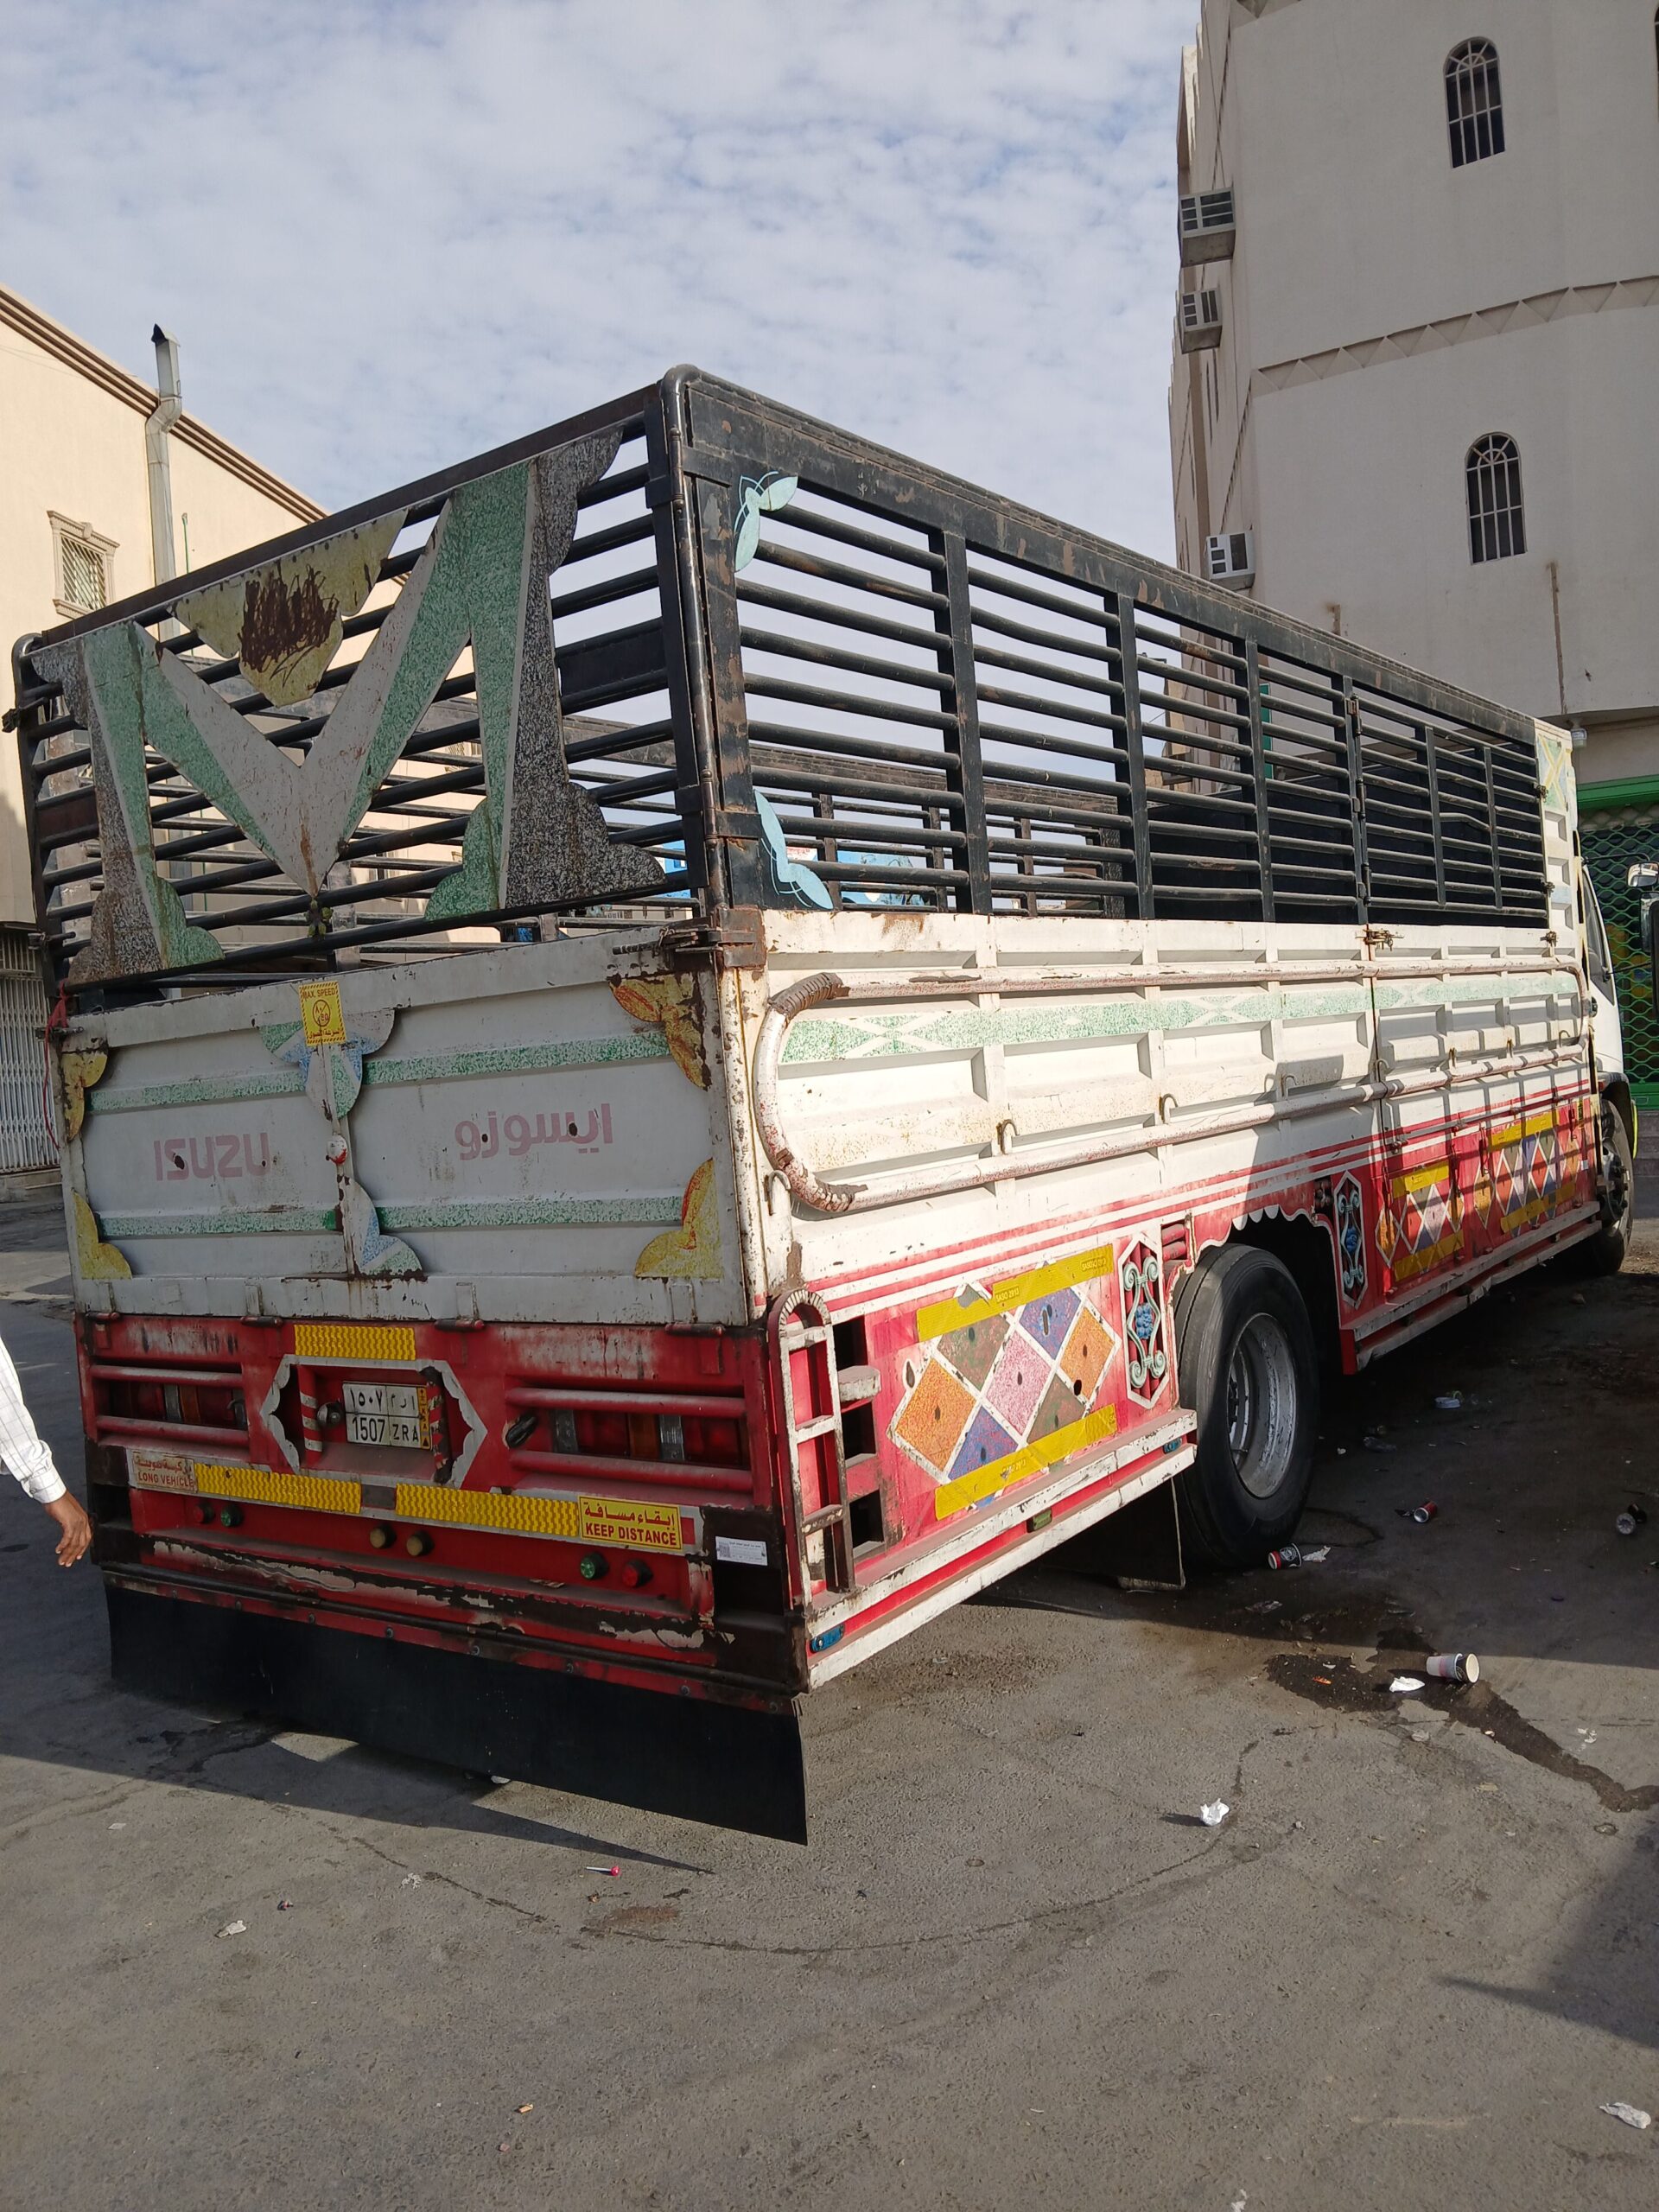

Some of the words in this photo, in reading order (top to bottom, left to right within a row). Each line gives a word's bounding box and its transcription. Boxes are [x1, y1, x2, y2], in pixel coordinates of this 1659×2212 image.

[317, 988, 335, 997] SPEED
[454, 1103, 613, 1160] ايسوزو
[154, 1132, 270, 1181] ISUZU
[353, 1417, 385, 1443] 1507
[392, 1424, 418, 1442] ZRA
[138, 1471, 159, 1484] LONG
[161, 1474, 194, 1487] VEHICLE
[584, 1502, 636, 1522] مسافة
[586, 1522, 614, 1537] KEEP
[618, 1526, 677, 1546] DISTANCE
